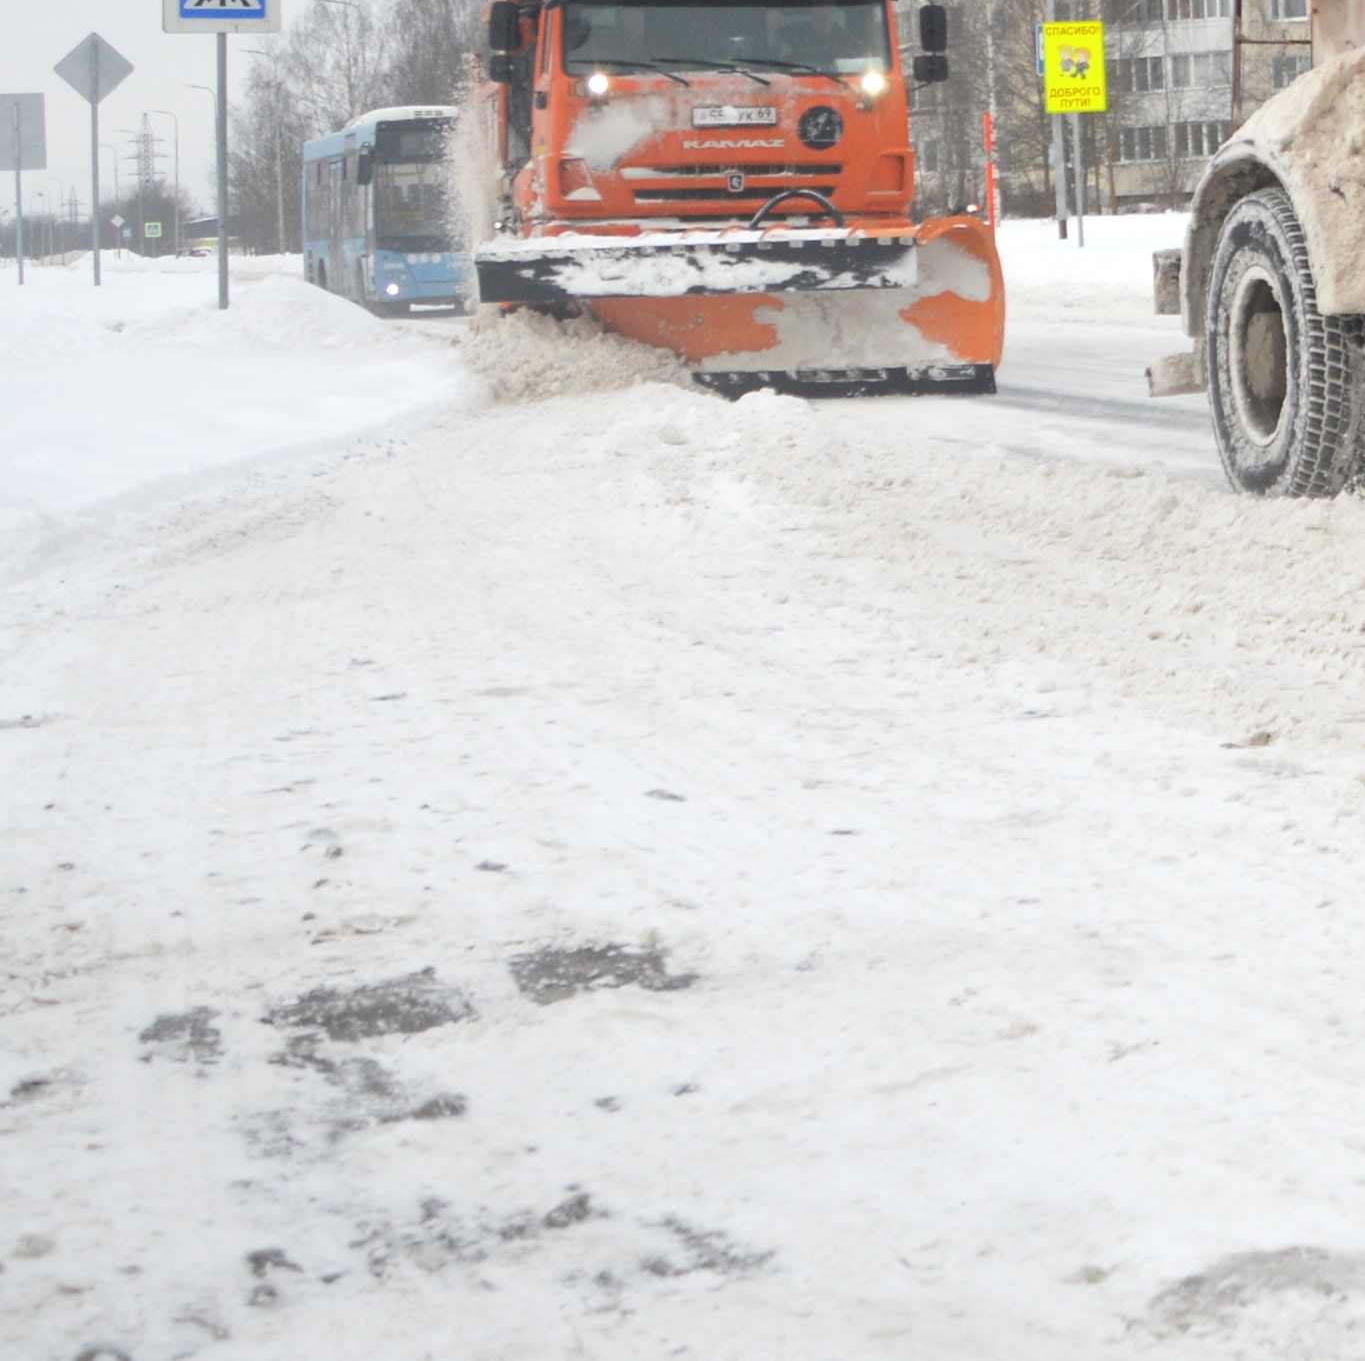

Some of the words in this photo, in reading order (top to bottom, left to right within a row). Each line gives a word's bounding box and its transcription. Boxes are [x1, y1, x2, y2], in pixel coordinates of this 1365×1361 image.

[1045, 25, 1099, 36] СПАСИБО!
[1049, 86, 1101, 99] ДОБРОГО
[1060, 98, 1091, 109] ПУТИ!
[757, 108, 771, 119] 69
[682, 139, 785, 149] KAMAZ
